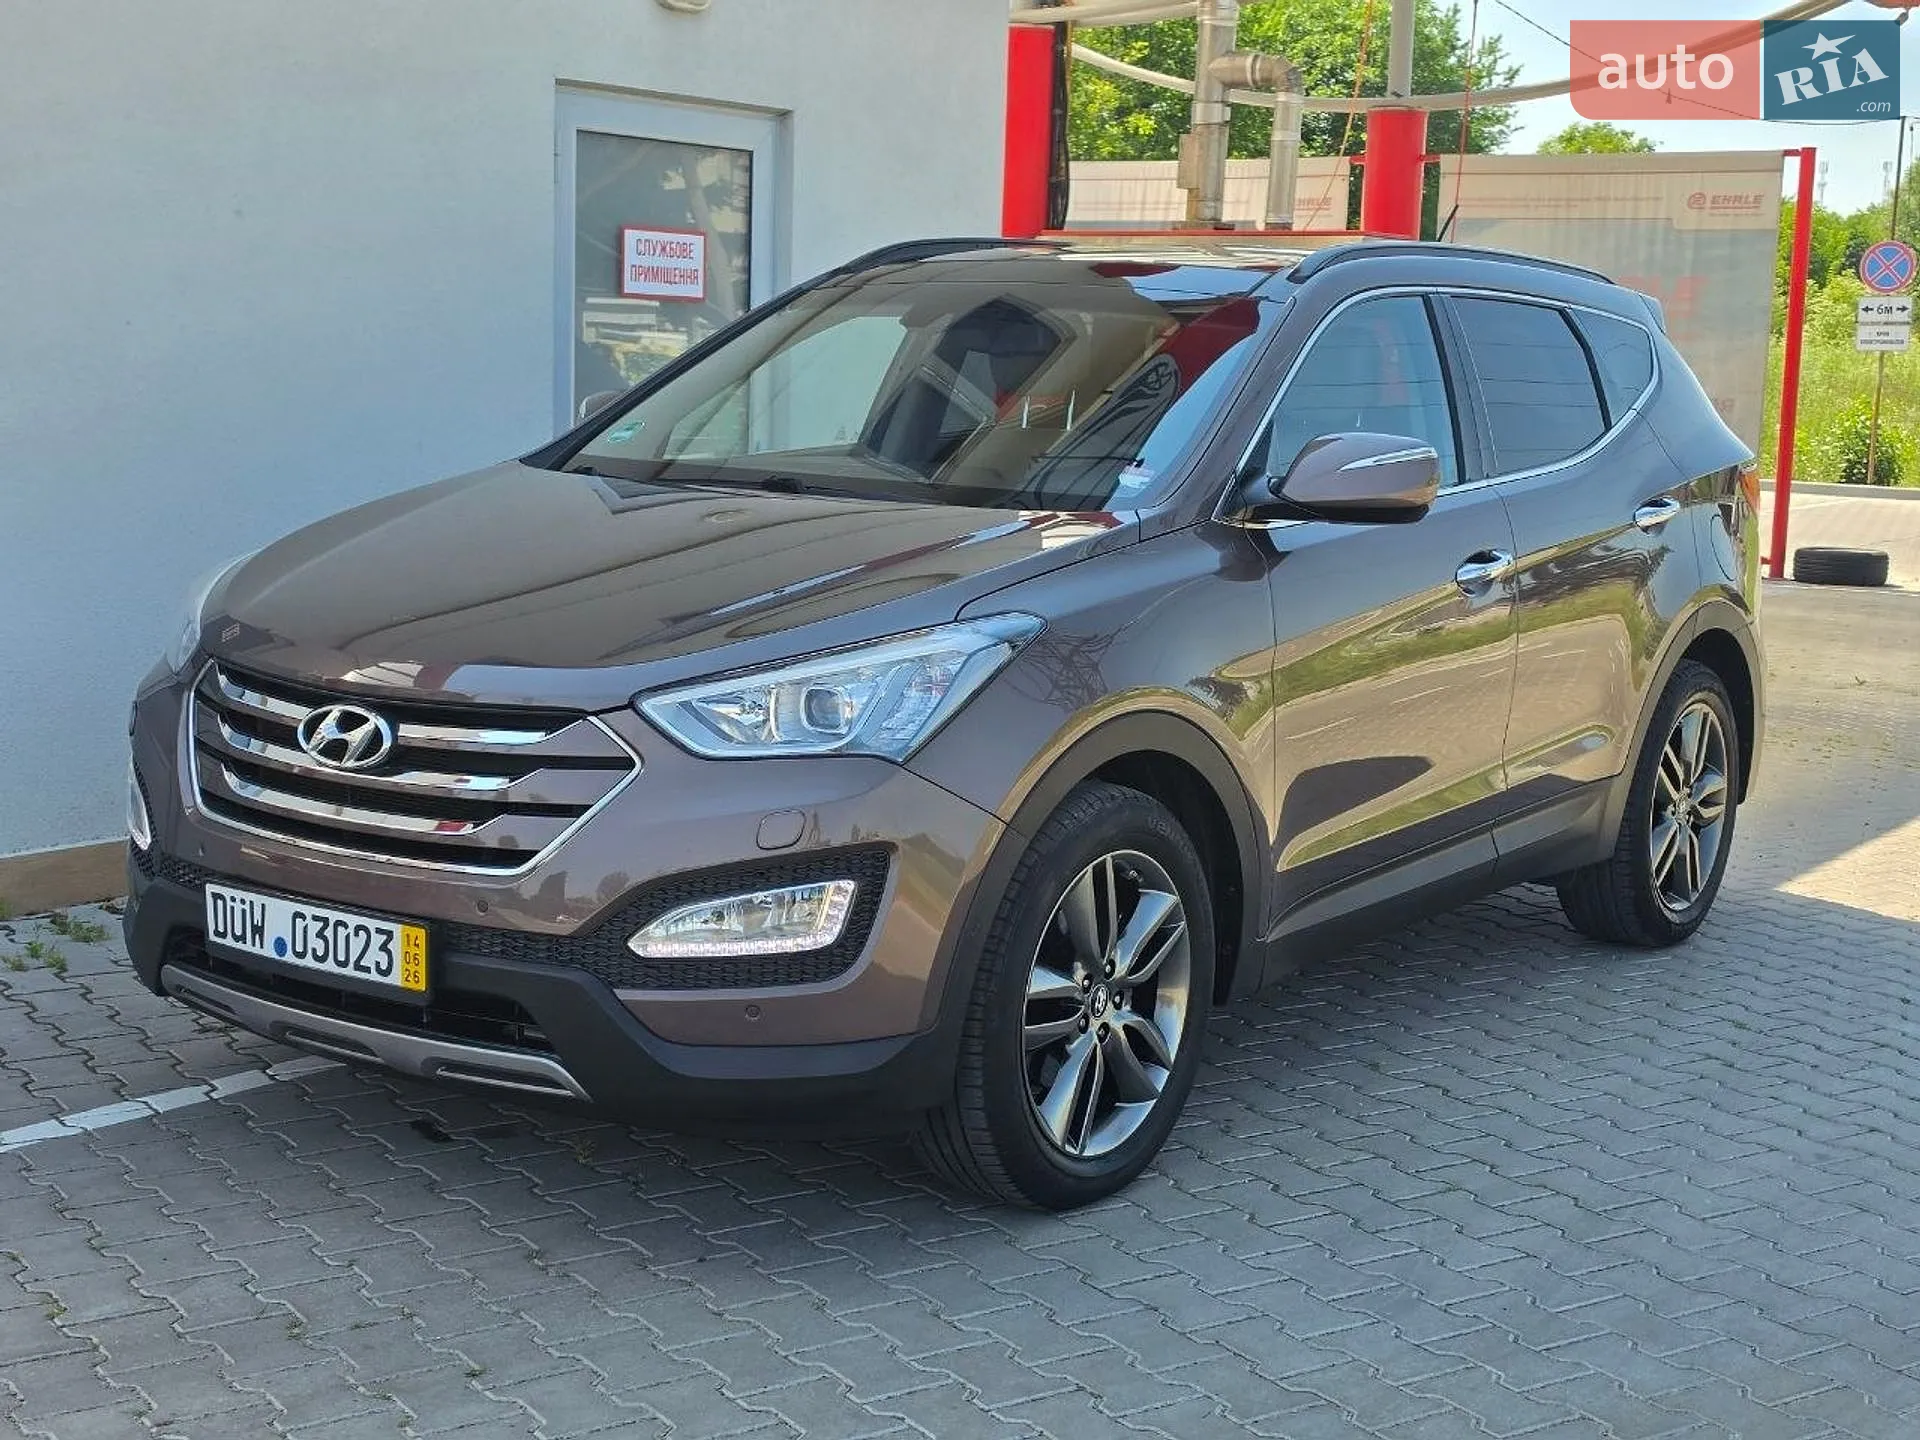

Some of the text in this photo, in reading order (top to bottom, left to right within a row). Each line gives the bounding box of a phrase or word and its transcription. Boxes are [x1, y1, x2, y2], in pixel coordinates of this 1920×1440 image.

[635, 238, 695, 260] СЛУЖБОВЕ
[630, 264, 700, 286] ПРИМІЩЕННЯ
[209, 891, 395, 978] DÜW 03023
[405, 933, 421, 950] 14
[404, 950, 421, 967] 06
[404, 968, 421, 985] 26
